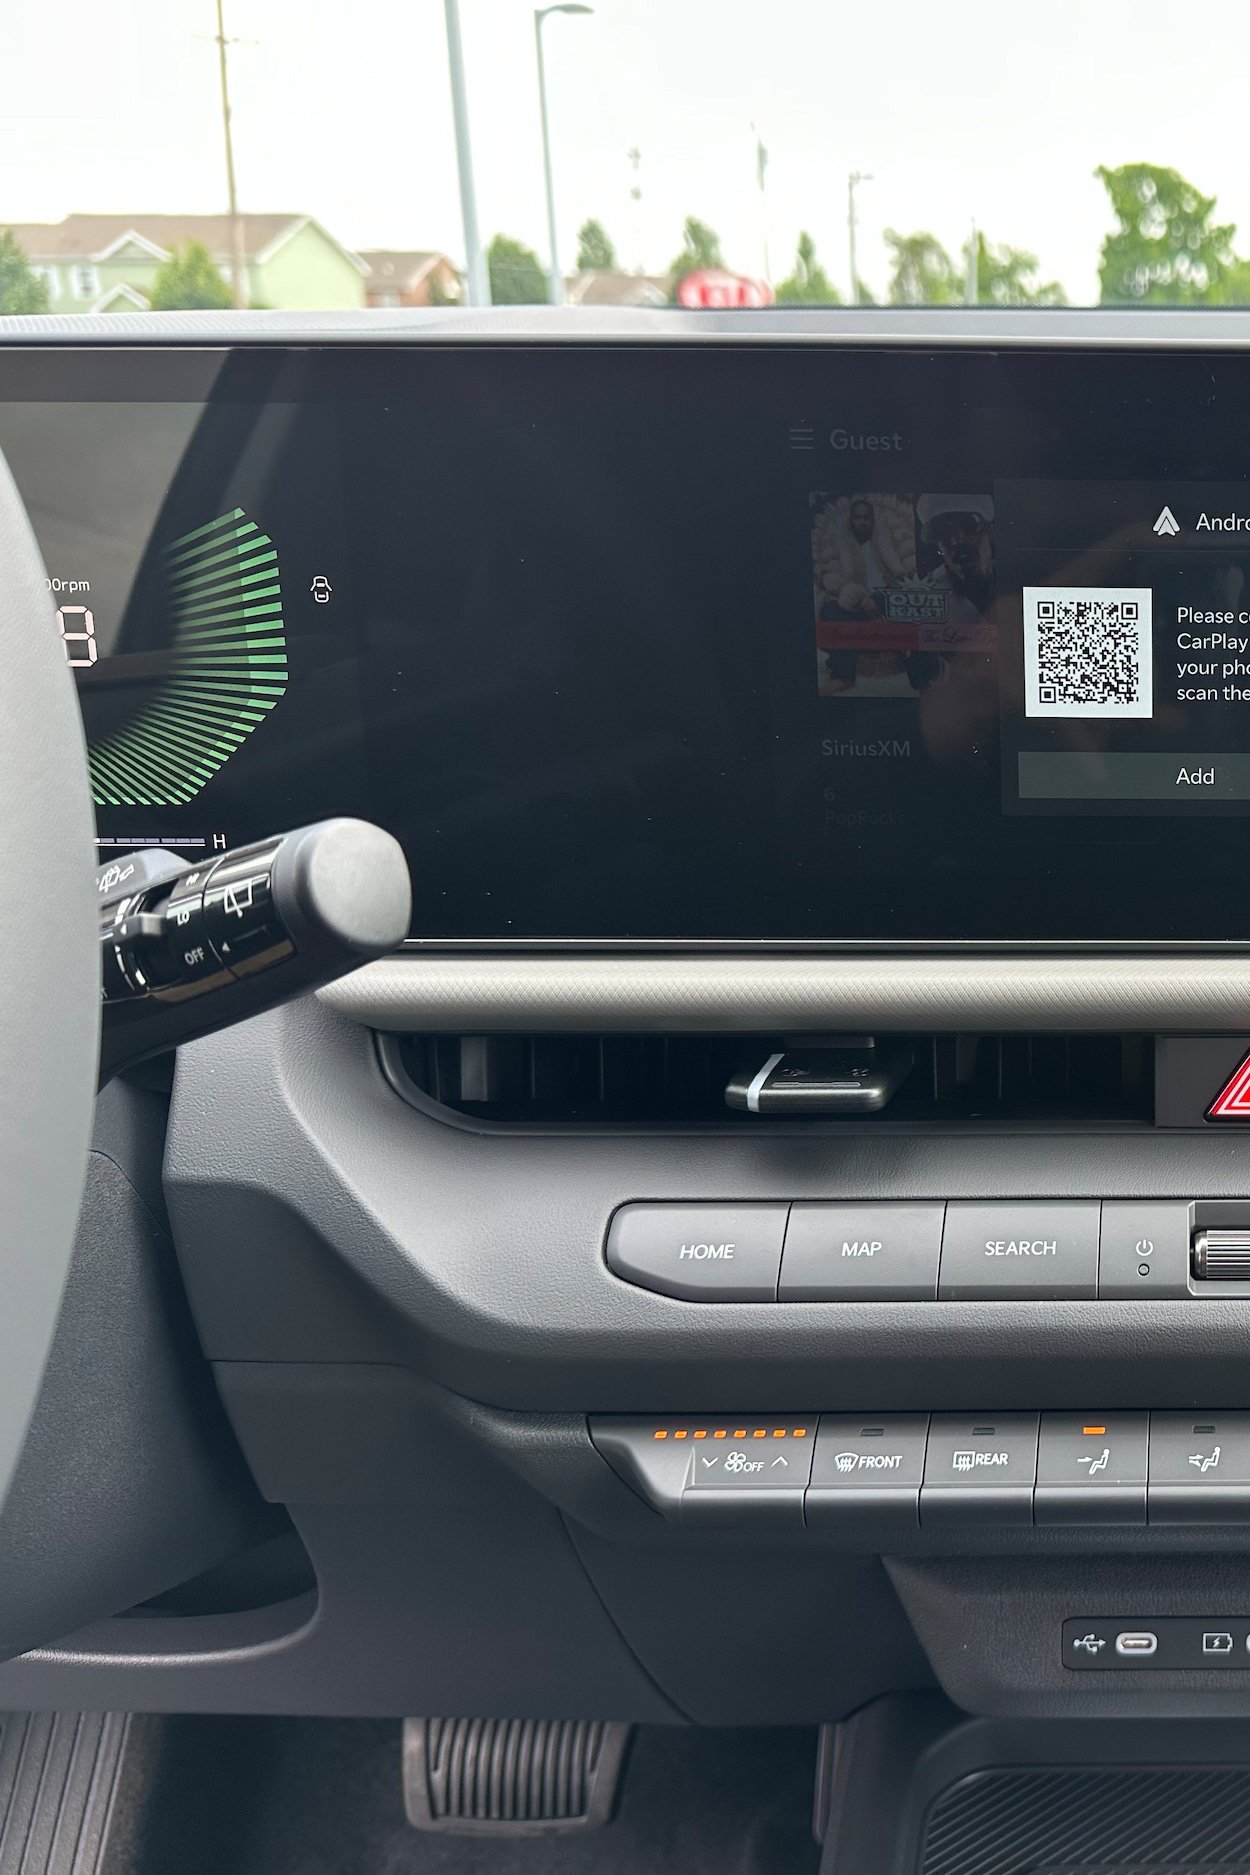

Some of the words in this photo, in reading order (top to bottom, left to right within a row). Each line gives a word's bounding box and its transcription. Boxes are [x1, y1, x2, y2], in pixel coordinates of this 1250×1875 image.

[829, 428, 903, 451] Guest
[1177, 606, 1235, 624] Please
[1177, 632, 1249, 654] CarPlay
[1176, 662, 1219, 679] your
[1176, 688, 1218, 701] scan
[821, 739, 911, 757] SiriusXM
[1175, 767, 1215, 785] Add
[823, 786, 835, 802] 6
[212, 833, 227, 850] H
[176, 910, 190, 927] LO
[184, 946, 206, 966] OFF
[679, 1244, 735, 1260] HOME
[841, 1241, 882, 1257] MAP
[984, 1240, 1057, 1256] SEARCH
[743, 1460, 765, 1473] OFF
[858, 1454, 903, 1470] FRONT
[974, 1452, 1009, 1467] REAR
